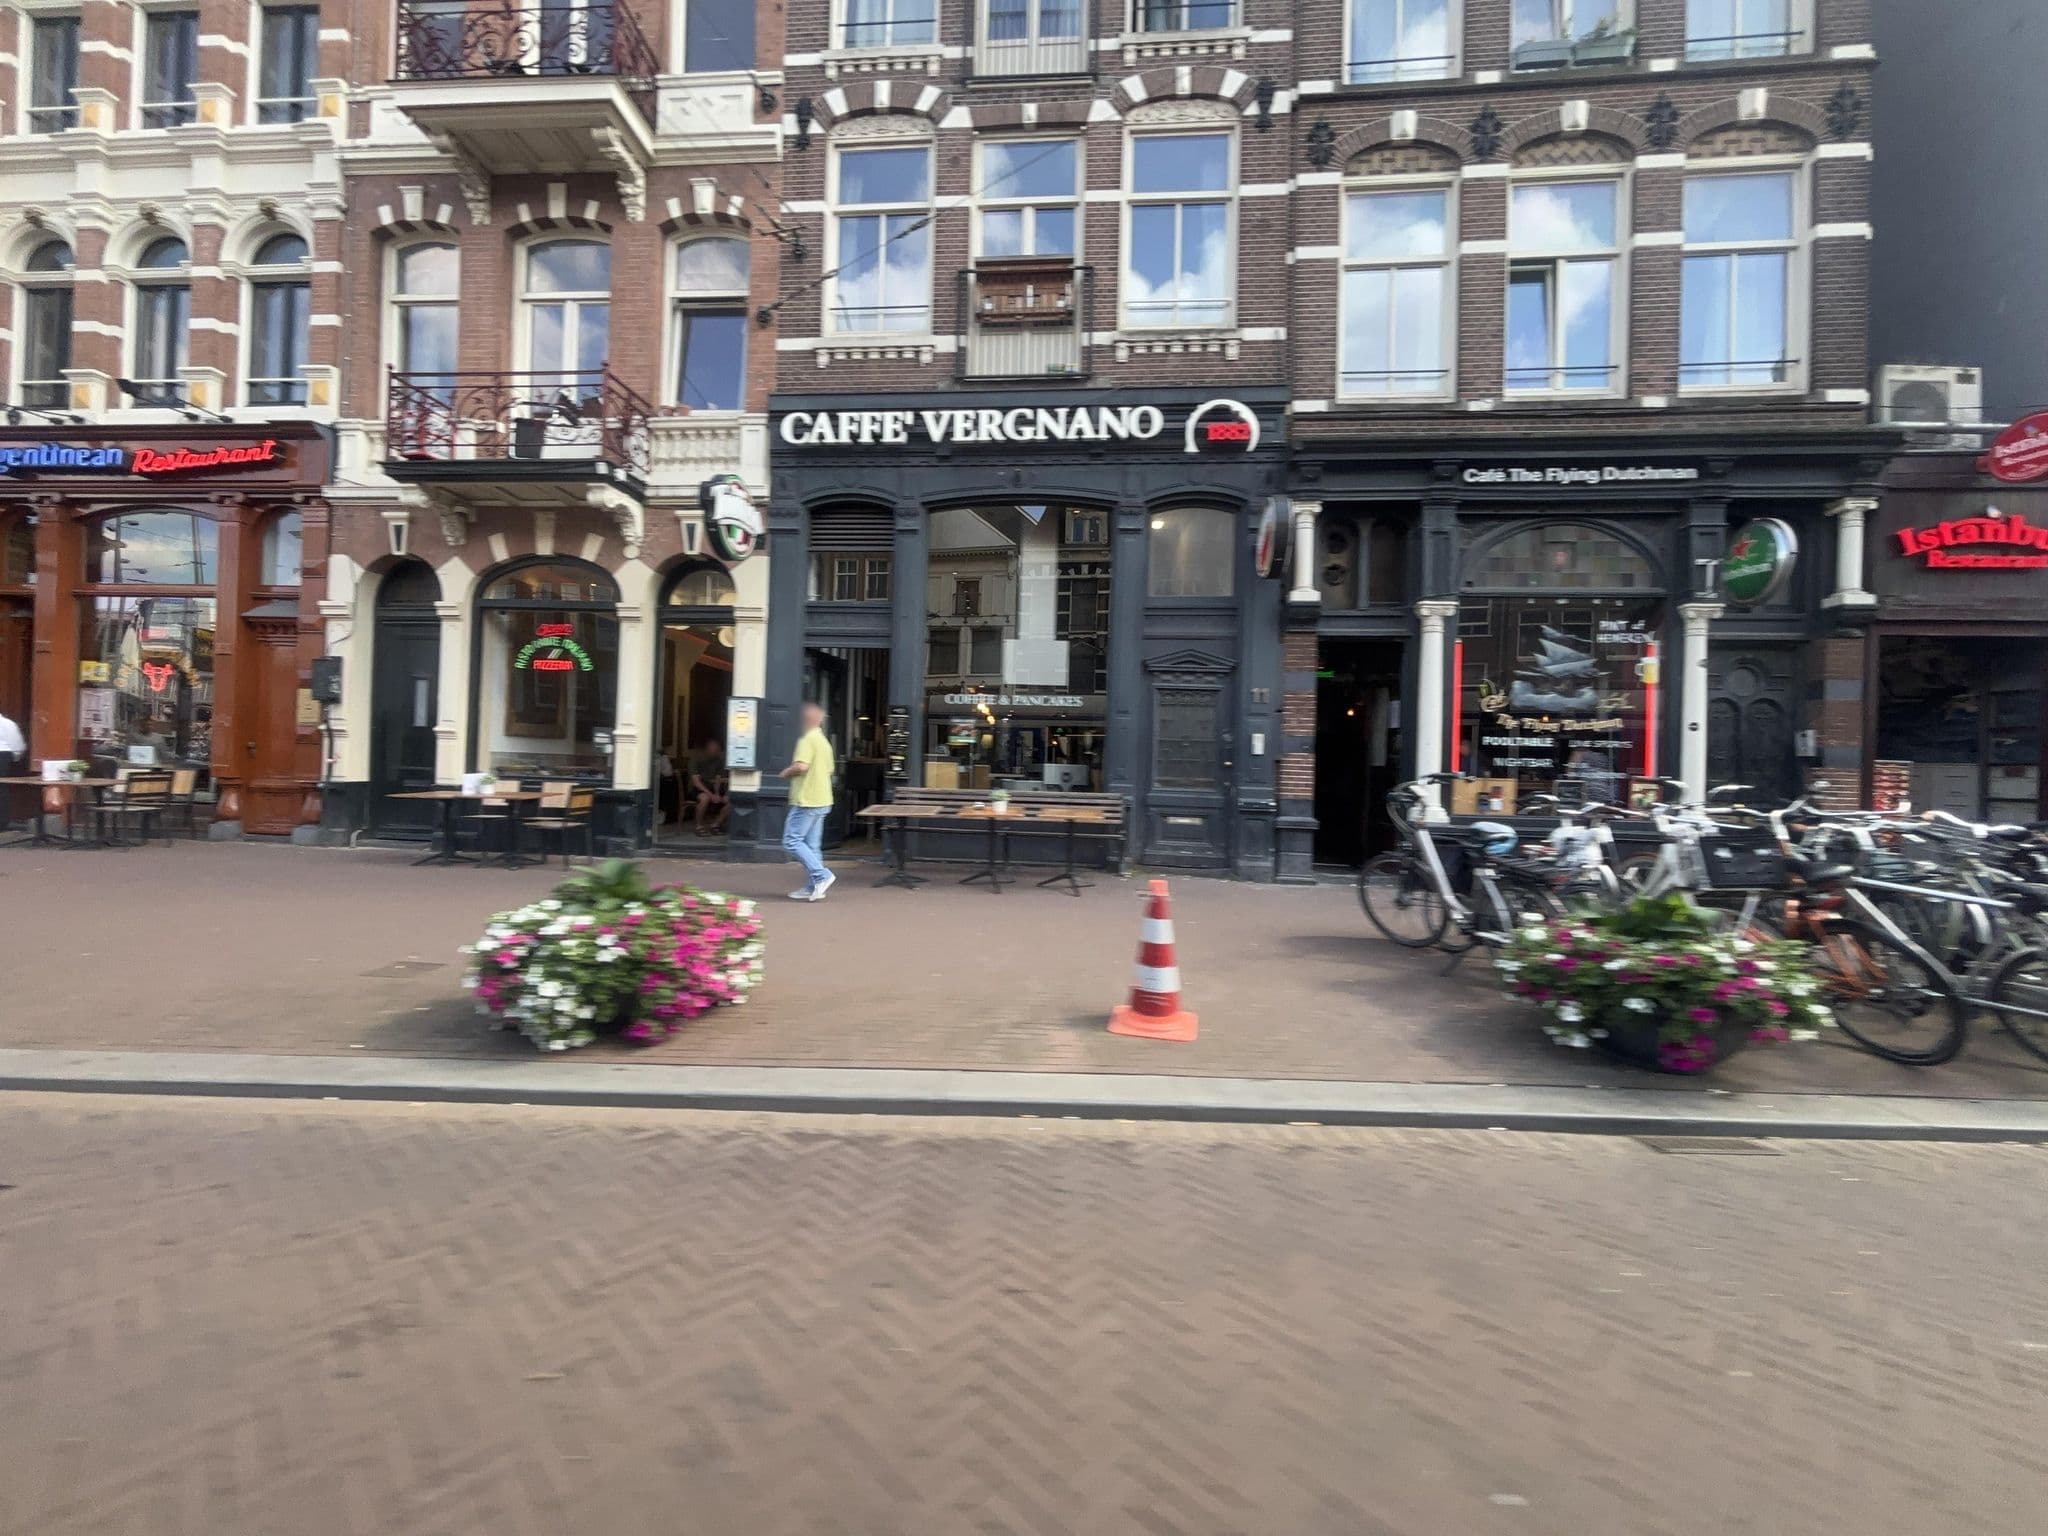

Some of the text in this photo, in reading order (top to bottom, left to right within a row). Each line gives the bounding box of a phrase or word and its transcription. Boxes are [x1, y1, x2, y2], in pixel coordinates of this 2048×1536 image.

[780, 405, 1164, 445] CAFFE' VERGNANO
[132, 440, 277, 473] Restaurant
[1463, 466, 1698, 484] Café The Flying Dutchman
